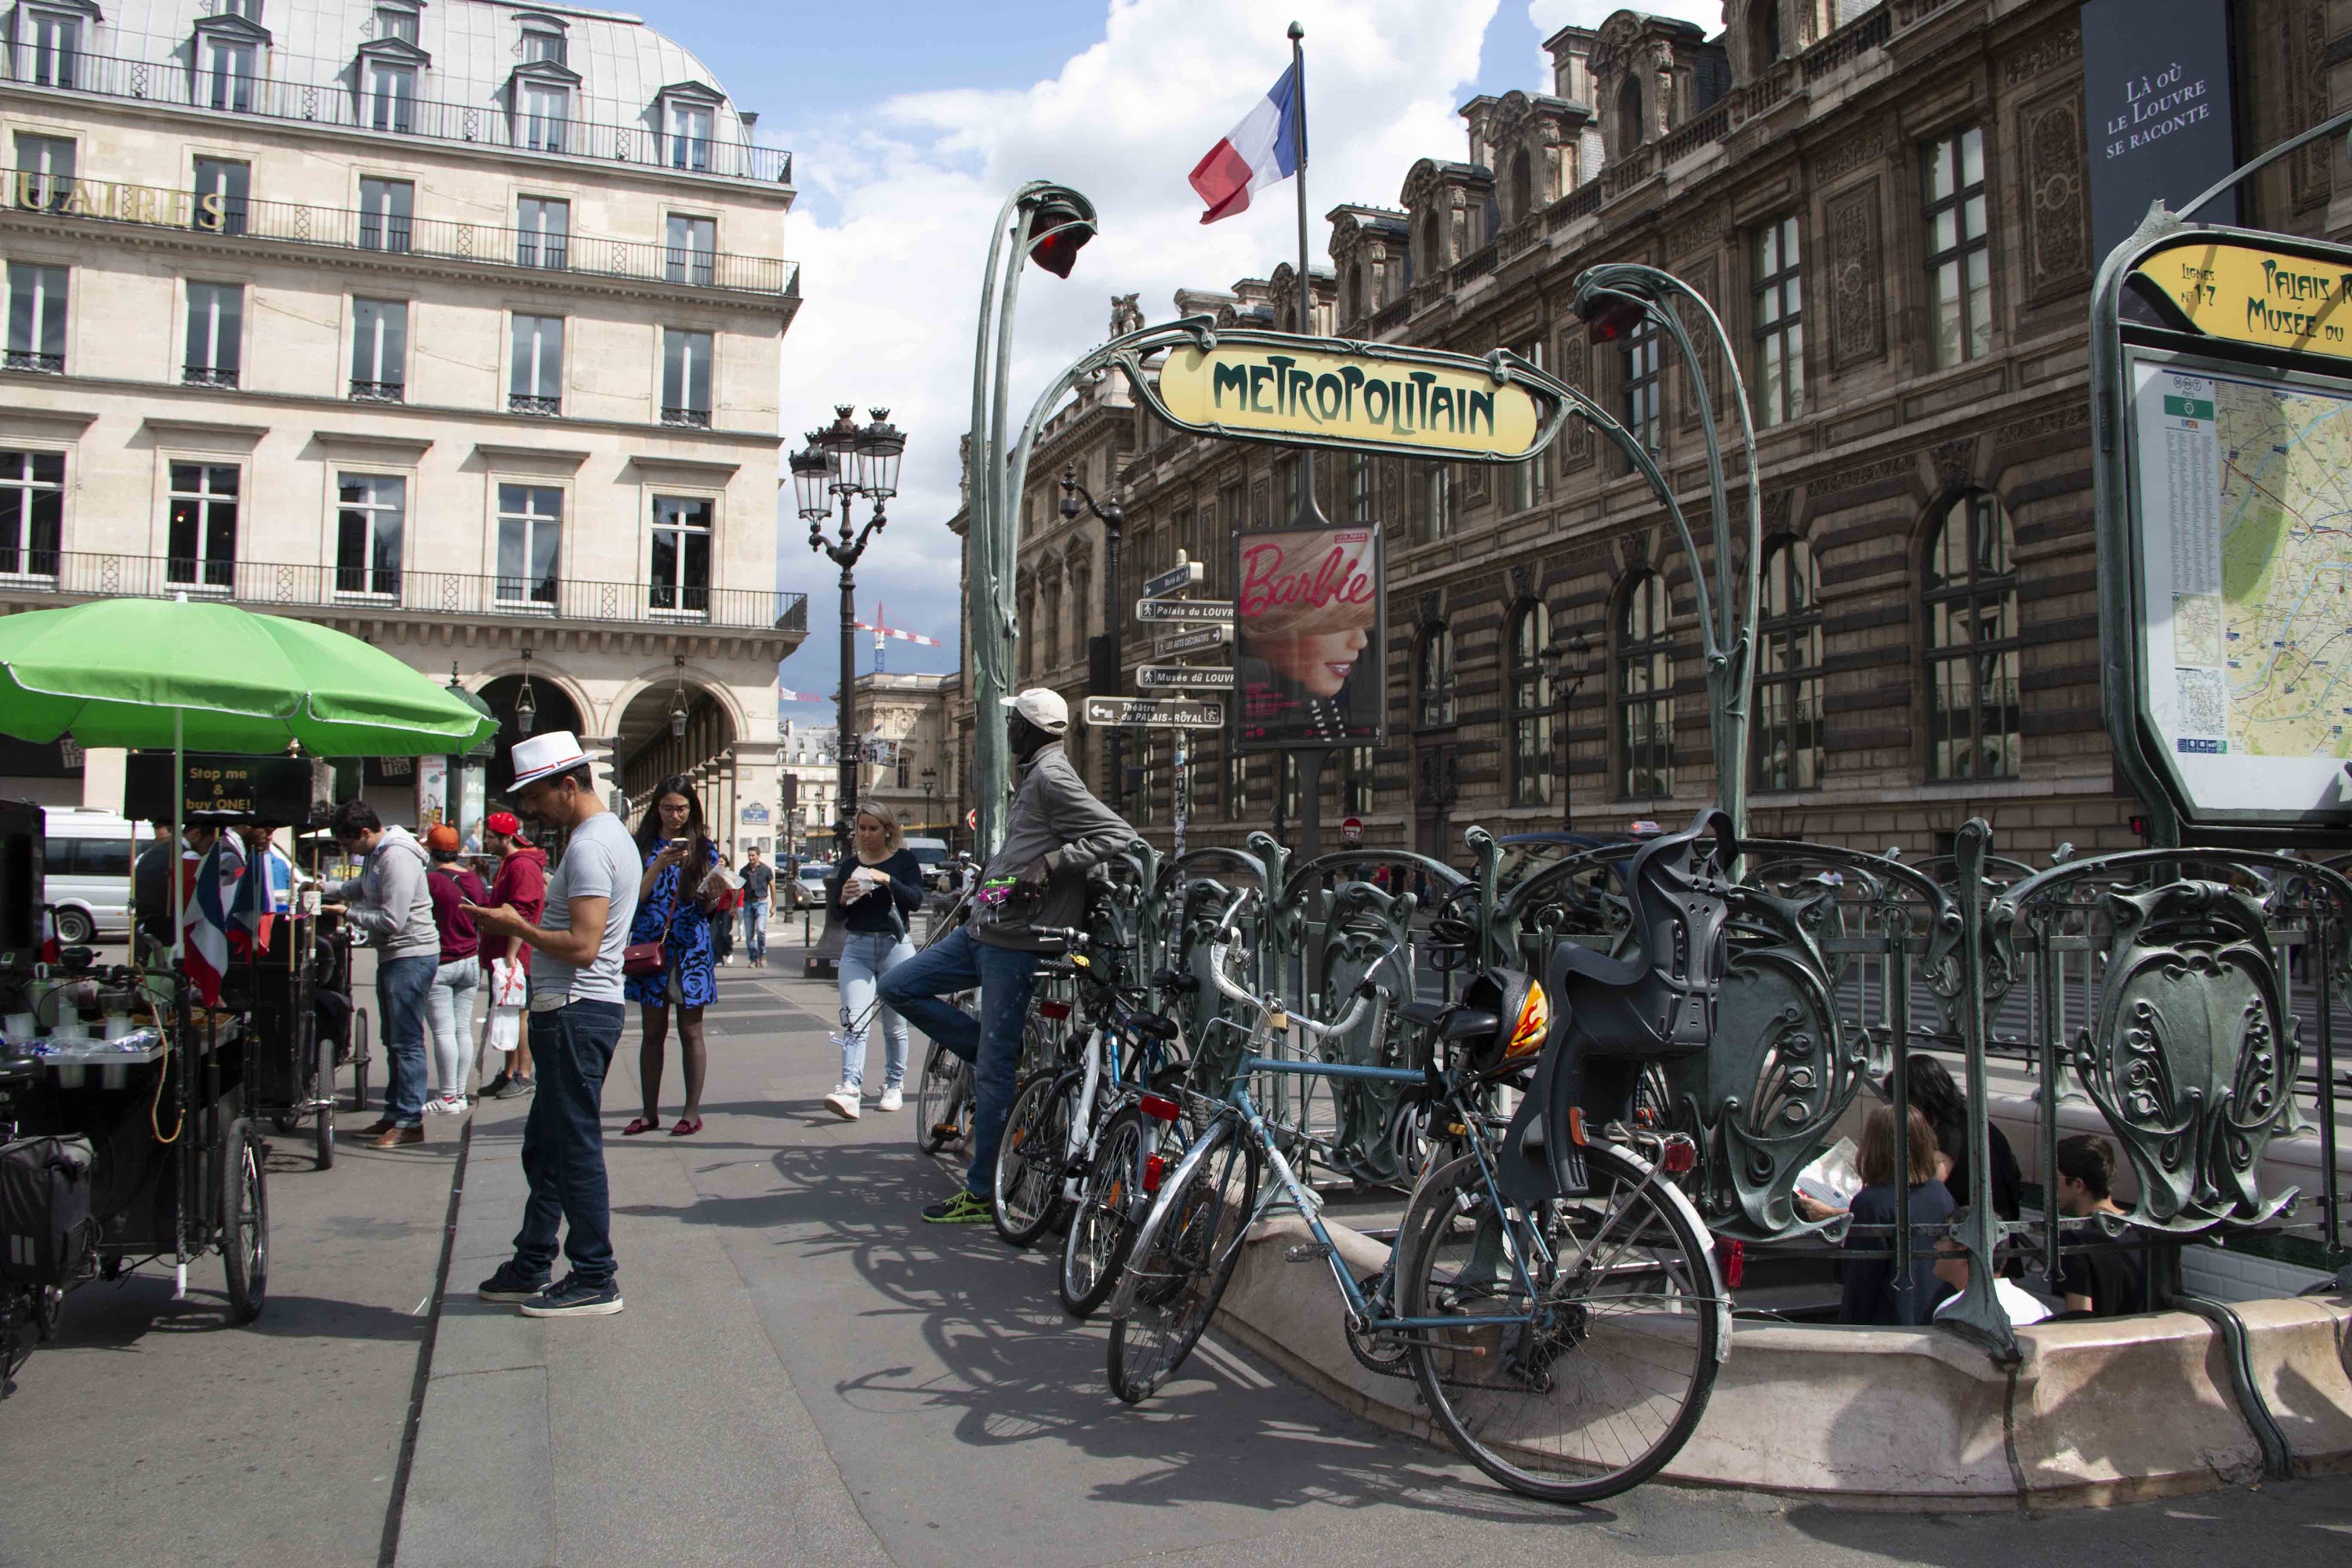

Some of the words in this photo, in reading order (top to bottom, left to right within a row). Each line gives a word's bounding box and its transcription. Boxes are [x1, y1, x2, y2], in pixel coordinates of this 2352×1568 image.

[2126, 76, 2152, 103] LÀ
[2157, 63, 2183, 88] OÙ
[2107, 115, 2129, 135] LE
[2132, 80, 2206, 124] LOUVRE
[2107, 140, 2125, 159] SE
[2129, 103, 2211, 150] RACONTE
[0, 171, 227, 230] UAIRES
[2261, 260, 2330, 302] PALAIS
[1214, 356, 1494, 437] METROPOLITAIN
[1239, 543, 1376, 617] Barbie
[1156, 606, 1185, 615] Palais
[1203, 608, 1234, 617] LOUVR
[1174, 638, 1184, 648] ARTS
[1156, 673, 1188, 681] Musée
[1122, 702, 1156, 713] Théâtre
[1121, 713, 1132, 721] du
[190, 768, 220, 781] Stop
[226, 769, 248, 779] me
[213, 784, 224, 795] &
[186, 798, 212, 811] buy
[216, 798, 251, 810] ONE!
